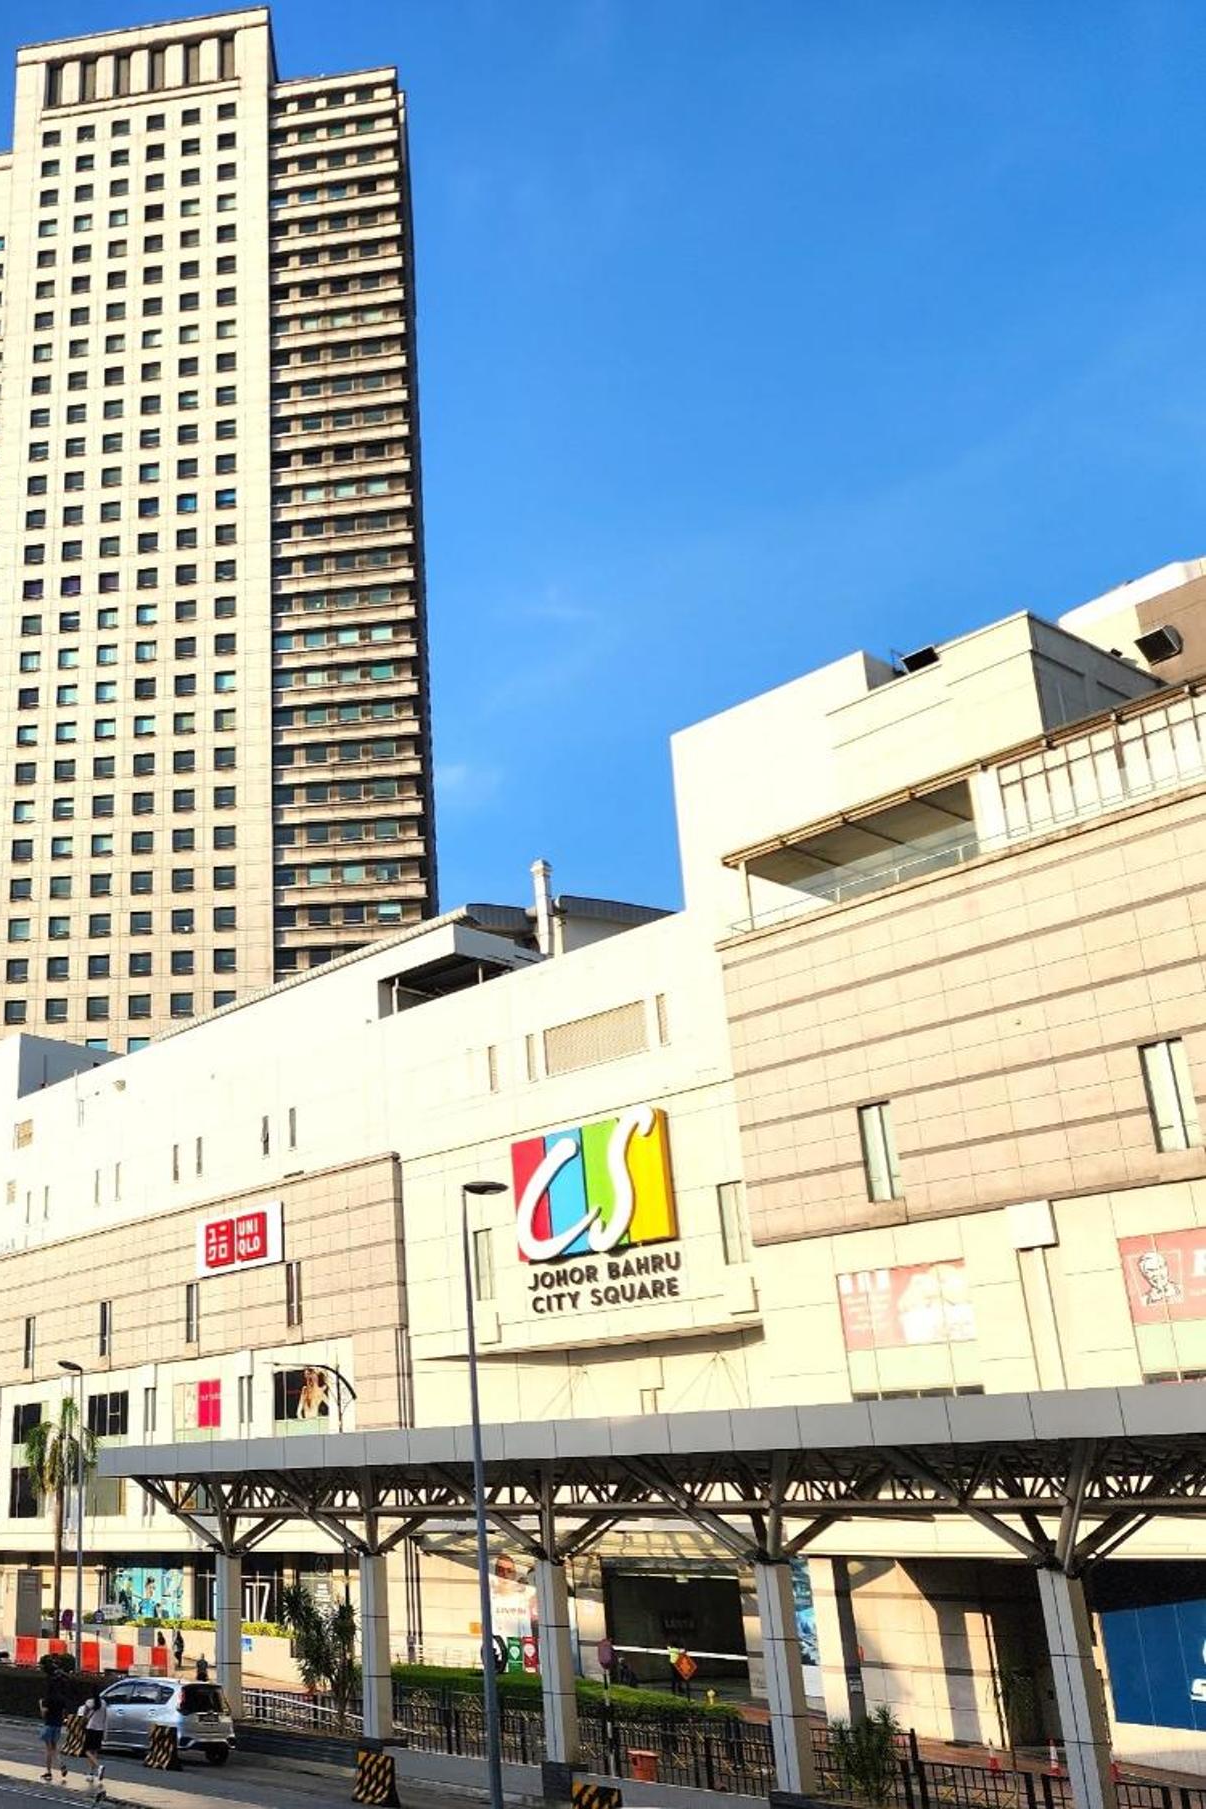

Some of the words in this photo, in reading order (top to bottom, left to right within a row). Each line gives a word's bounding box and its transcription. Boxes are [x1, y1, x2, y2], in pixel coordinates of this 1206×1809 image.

[237, 1217, 259, 1237] UNI
[238, 1235, 261, 1257] QLO
[527, 1264, 599, 1292] JOHOR
[606, 1251, 682, 1280] BAHRU
[531, 1290, 581, 1314] CITY
[590, 1276, 681, 1307] SQUARE
